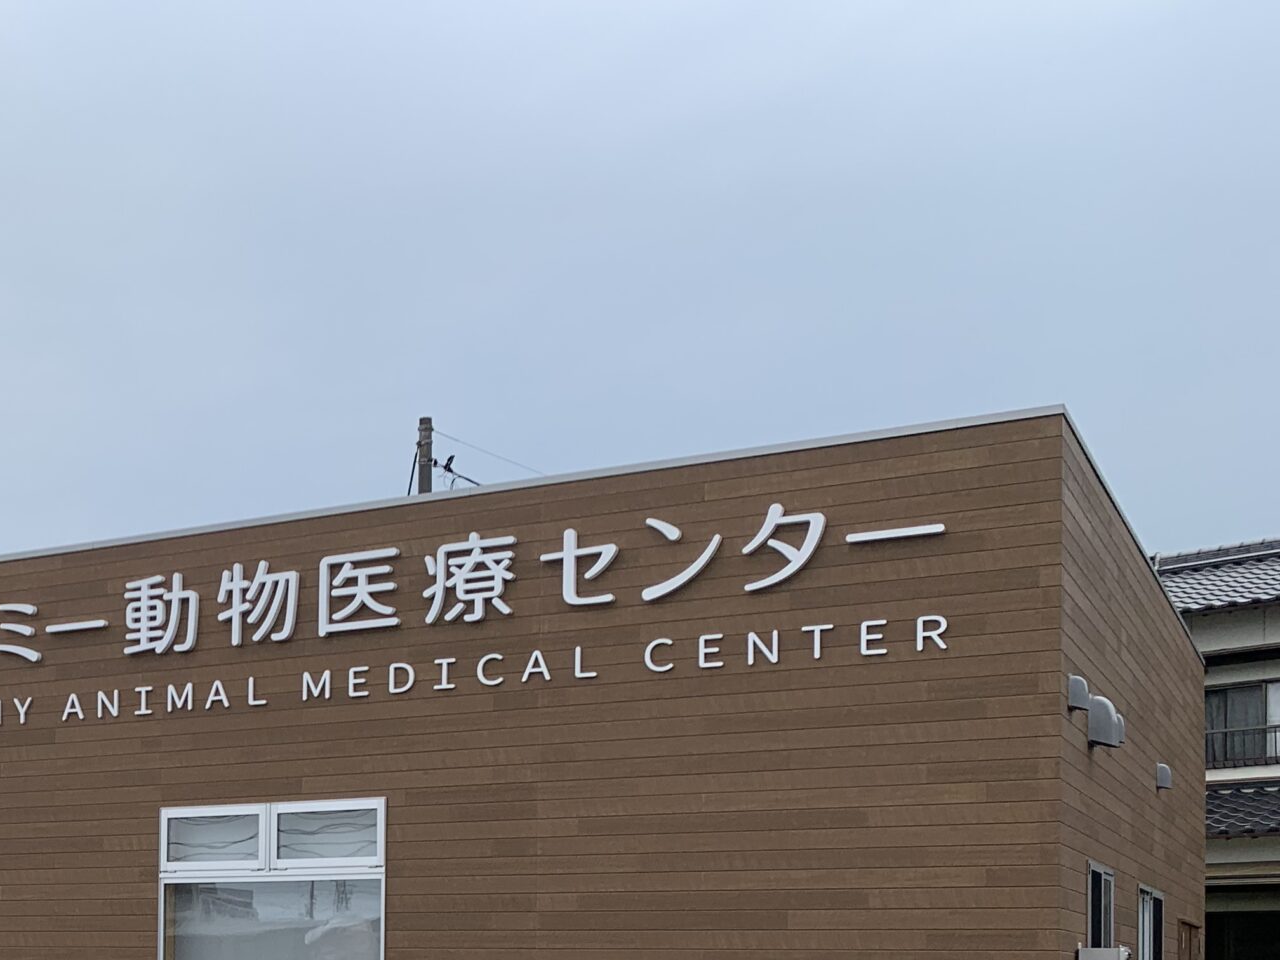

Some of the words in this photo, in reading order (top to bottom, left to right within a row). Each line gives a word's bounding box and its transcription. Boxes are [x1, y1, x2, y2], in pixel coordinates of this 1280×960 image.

[62, 676, 268, 721] ANIMAL
[301, 646, 598, 700] MEDICAL
[643, 614, 949, 673] CENTER
